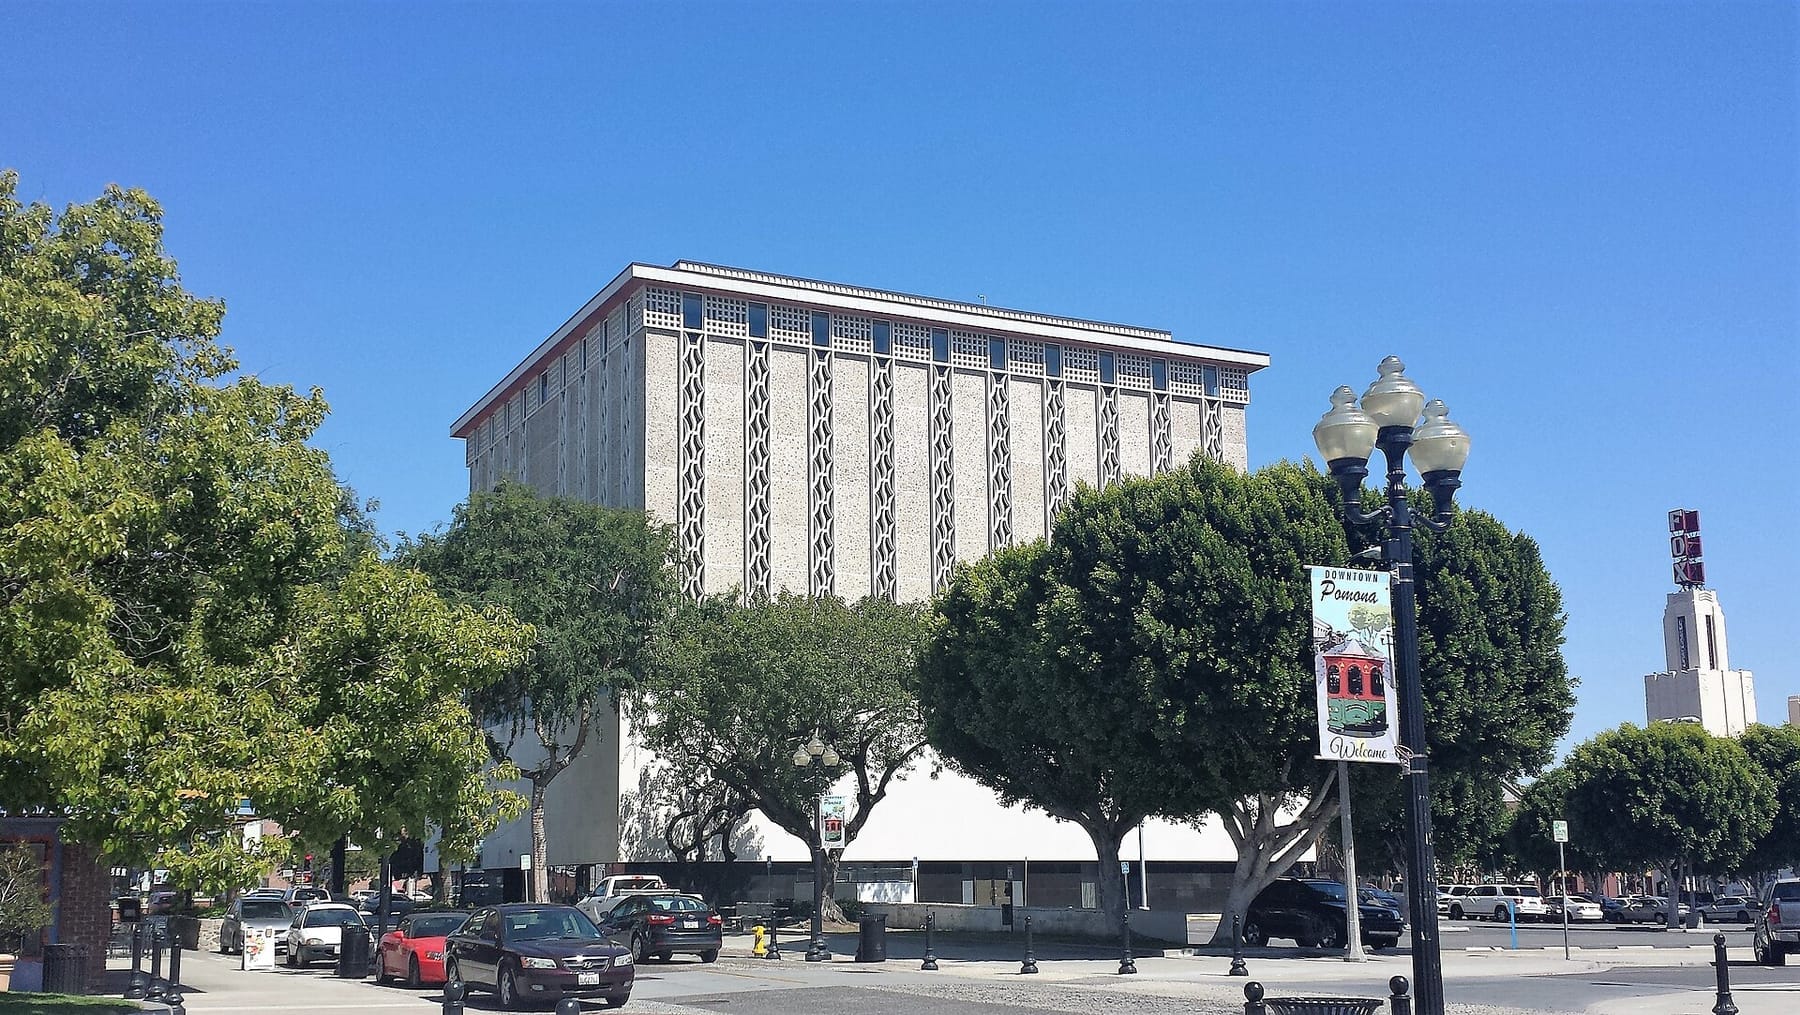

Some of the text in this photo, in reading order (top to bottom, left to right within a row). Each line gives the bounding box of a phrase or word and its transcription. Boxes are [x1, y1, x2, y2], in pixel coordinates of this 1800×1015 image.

[1669, 510, 1688, 582] FOX
[1325, 569, 1378, 583] DOWNTOWN
[1320, 579, 1378, 604] Pomona
[1330, 736, 1387, 759] Welcome
